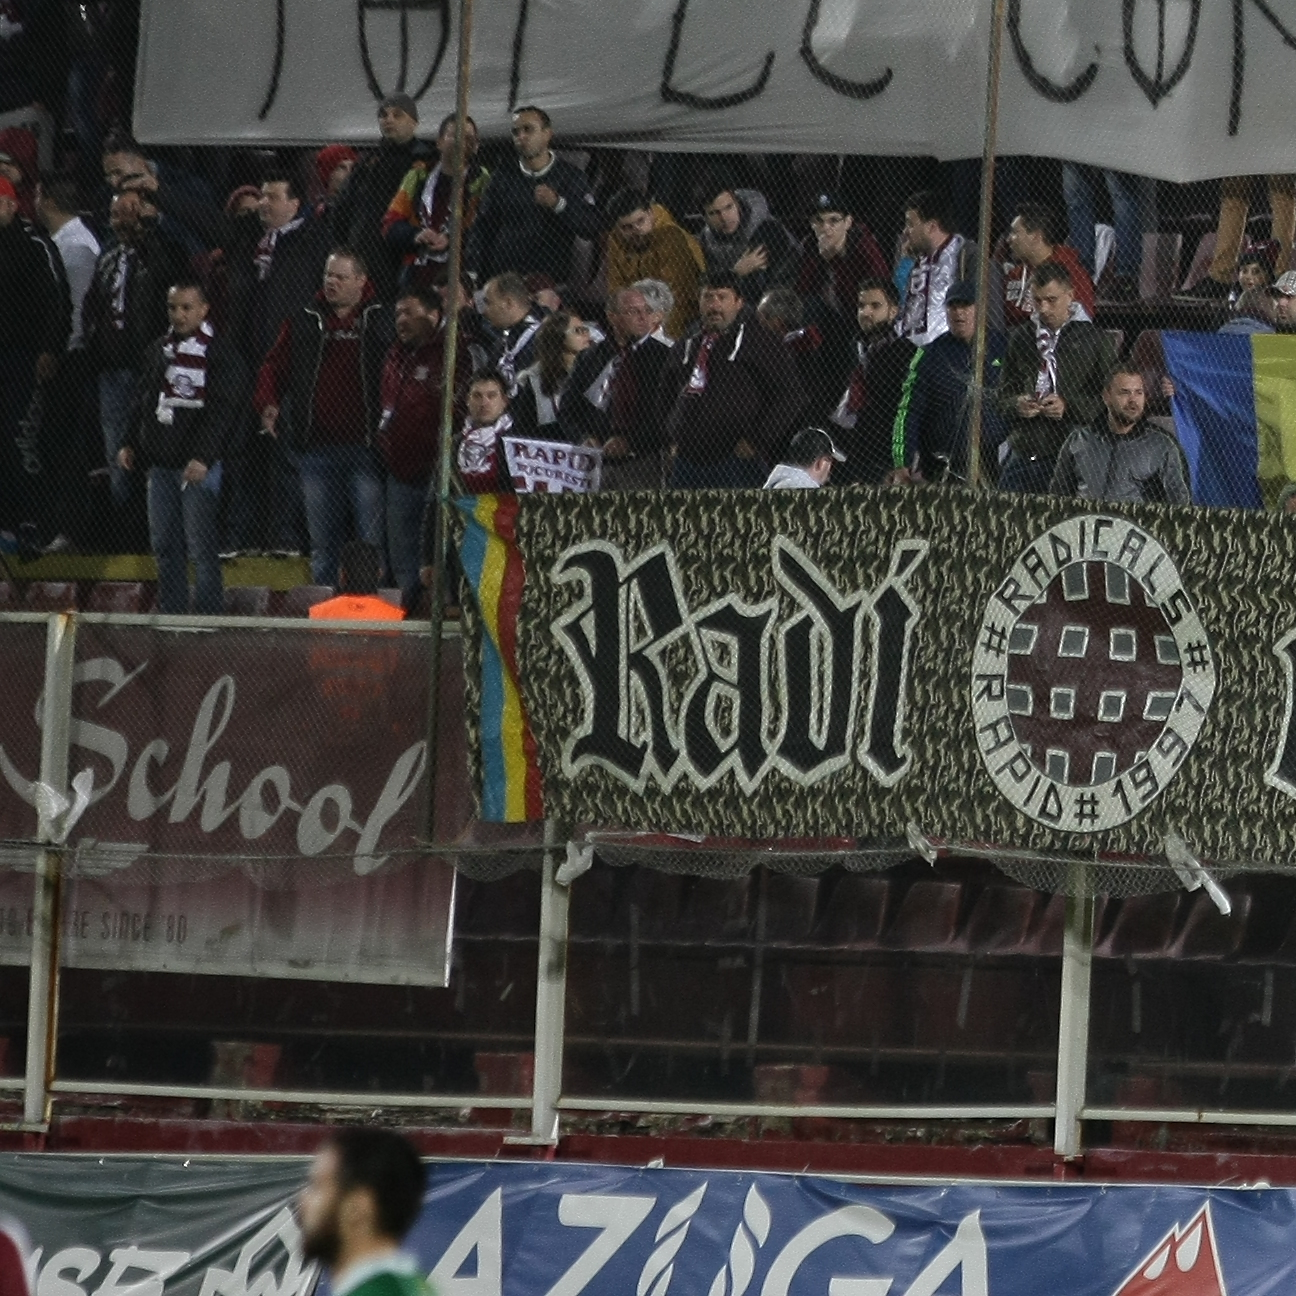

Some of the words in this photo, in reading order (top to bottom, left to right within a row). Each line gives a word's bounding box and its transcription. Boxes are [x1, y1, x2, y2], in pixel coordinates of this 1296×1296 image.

[511, 442, 597, 473] RAPID
[996, 518, 1192, 622] RADICALS
[0, 657, 428, 876] School
[974, 673, 1063, 822] RAPID
